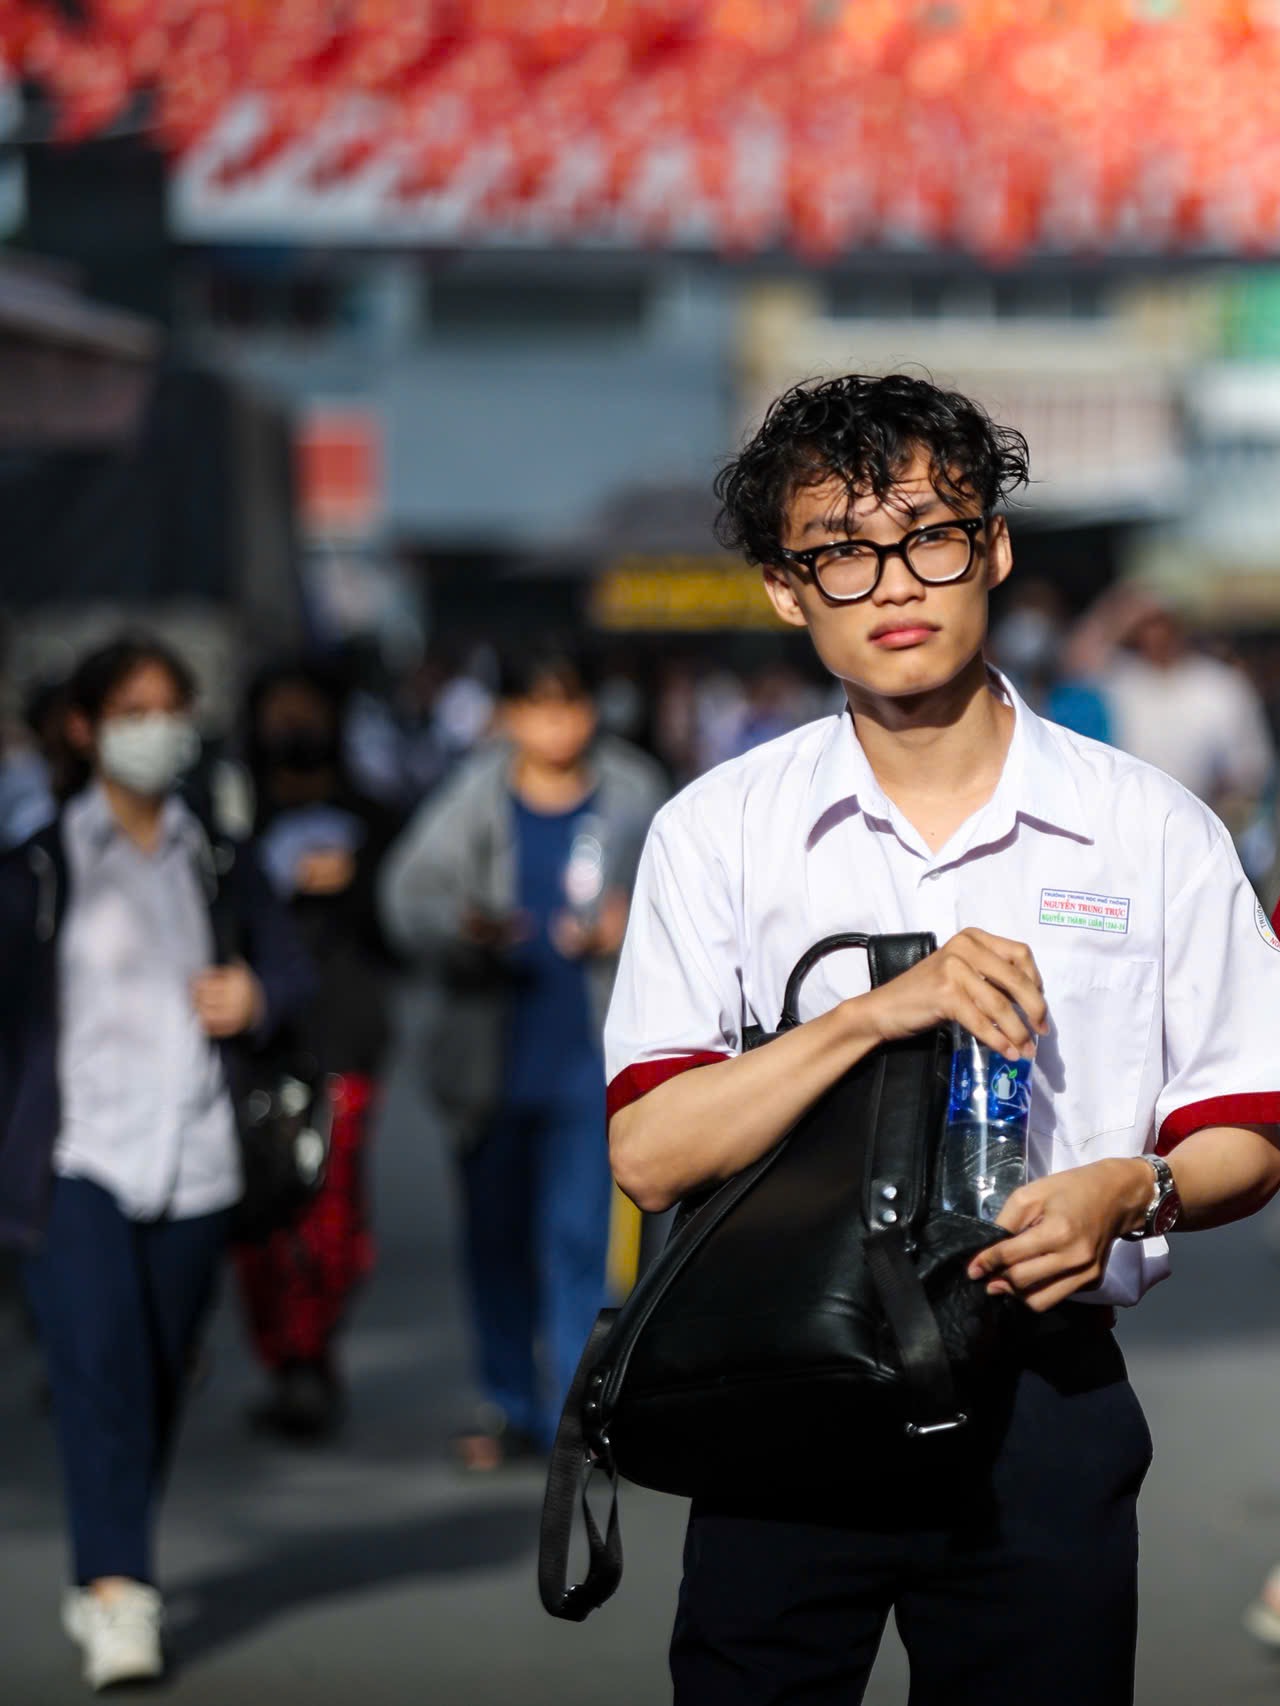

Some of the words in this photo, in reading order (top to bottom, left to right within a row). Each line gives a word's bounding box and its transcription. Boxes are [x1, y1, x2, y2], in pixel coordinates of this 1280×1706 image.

[1043, 899, 1076, 910] NGUYỄN
[1077, 903, 1103, 914] TRUNG
[1104, 907, 1126, 918] TRỰC
